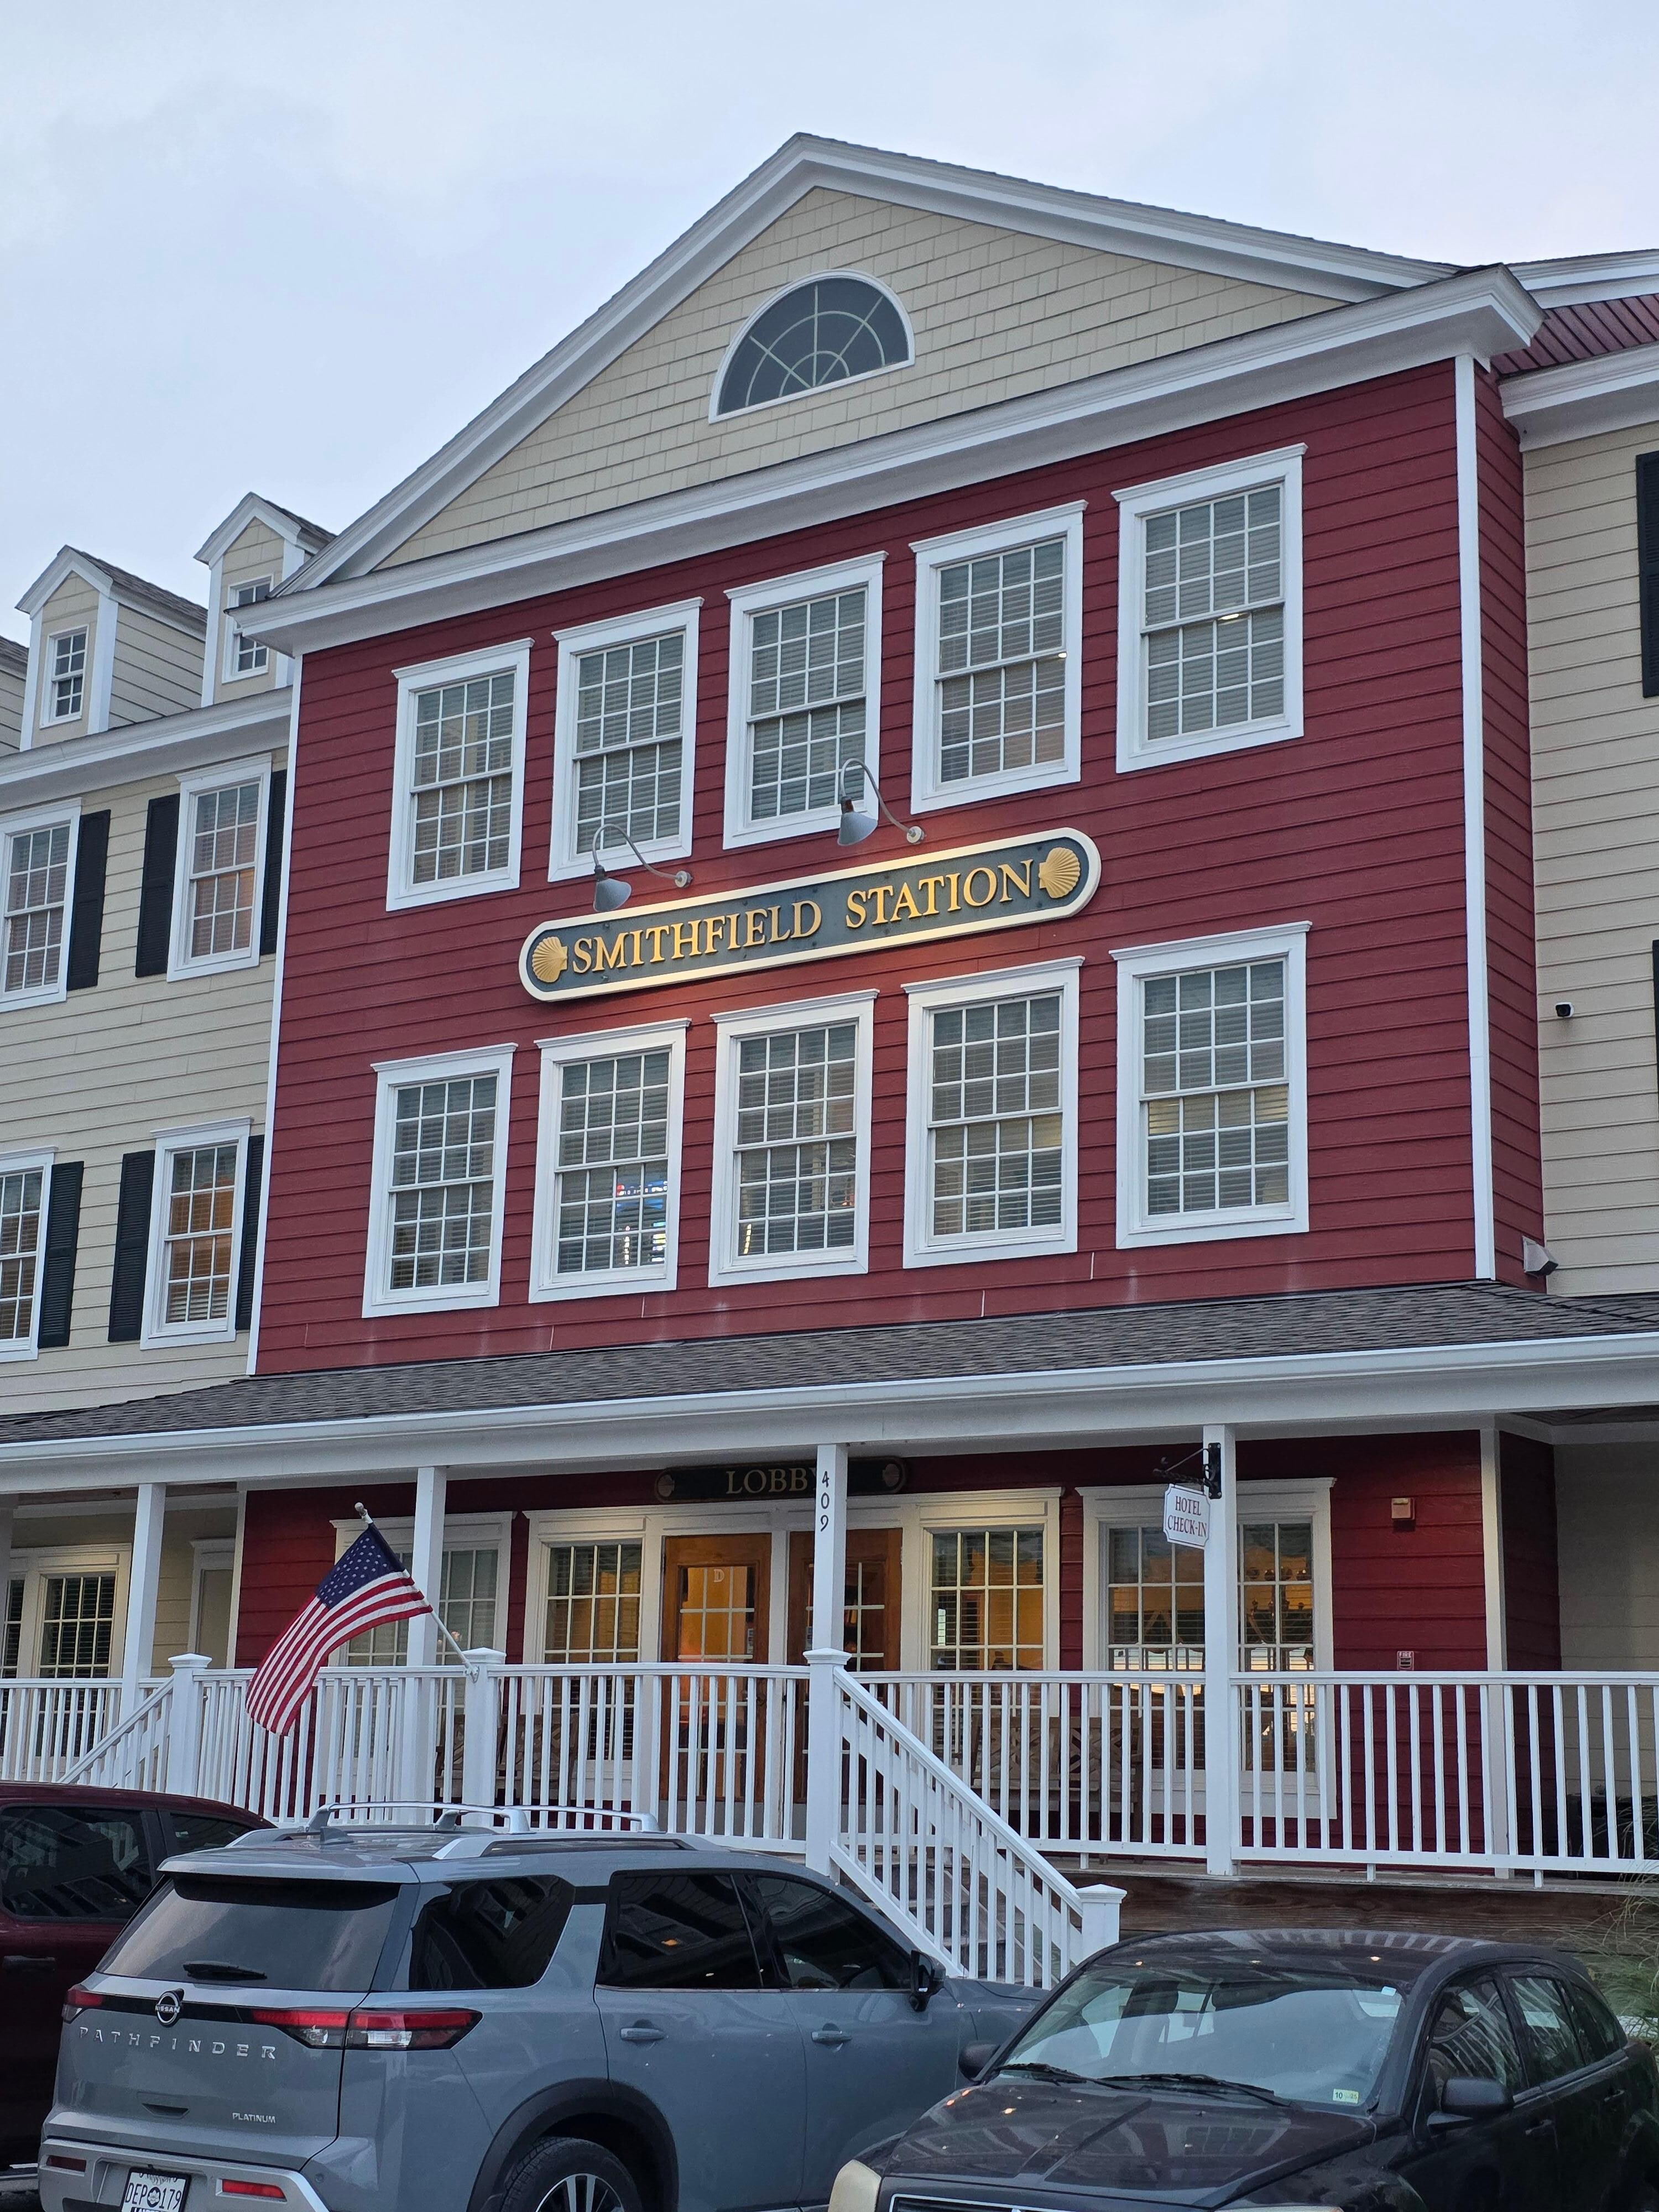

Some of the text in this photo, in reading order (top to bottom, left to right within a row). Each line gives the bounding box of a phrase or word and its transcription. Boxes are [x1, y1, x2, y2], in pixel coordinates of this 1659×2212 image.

[572, 859, 1032, 973] SMITHFIELD STATION
[726, 1468, 816, 1494] LOBB
[821, 1470, 830, 1532] 409
[1175, 1496, 1201, 1516] HOTEL
[1167, 1515, 1207, 1537] CHECK-IN
[79, 2027, 275, 2059] PATHFINDER
[232, 2112, 275, 2124] PLATINUM
[125, 2183, 181, 2210] DEP 179
